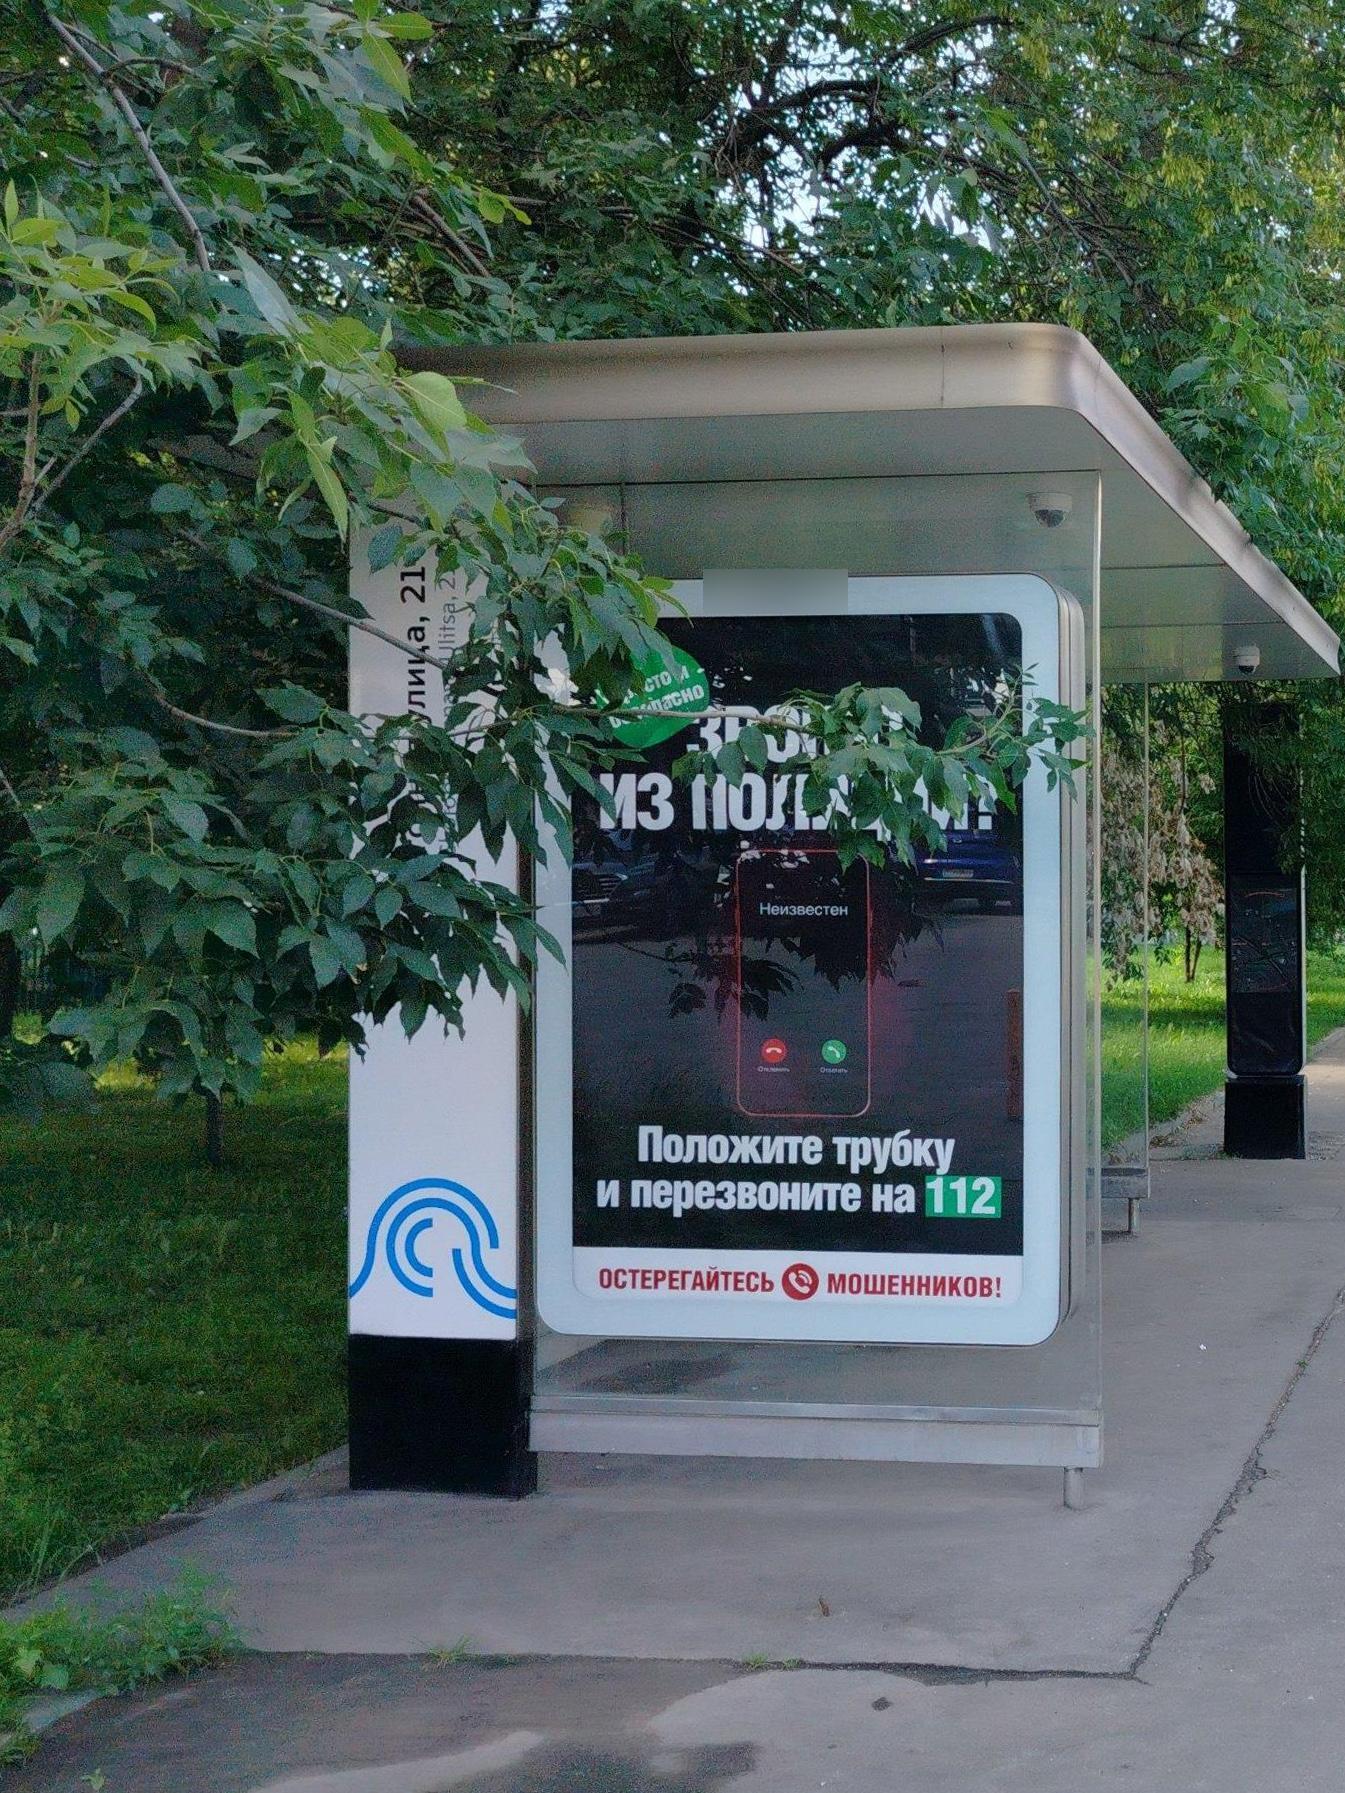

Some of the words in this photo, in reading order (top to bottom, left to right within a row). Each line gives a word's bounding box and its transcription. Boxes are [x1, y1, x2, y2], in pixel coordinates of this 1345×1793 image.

[400, 566, 426, 603] 21
[438, 570, 456, 590] 2
[599, 772, 675, 831] ИЗ
[759, 902, 849, 917] Неизвестен
[638, 1125, 823, 1166] Положите
[832, 1129, 956, 1175] трубку
[597, 1180, 619, 1208] и
[631, 1180, 862, 1218] перезвоните
[872, 1184, 915, 1213] на
[926, 1176, 996, 1216] 112
[599, 1266, 775, 1293] ОСТЕРЕГАЙТЕСЬ
[827, 1274, 1002, 1298] МОШЕННИКОВ!
